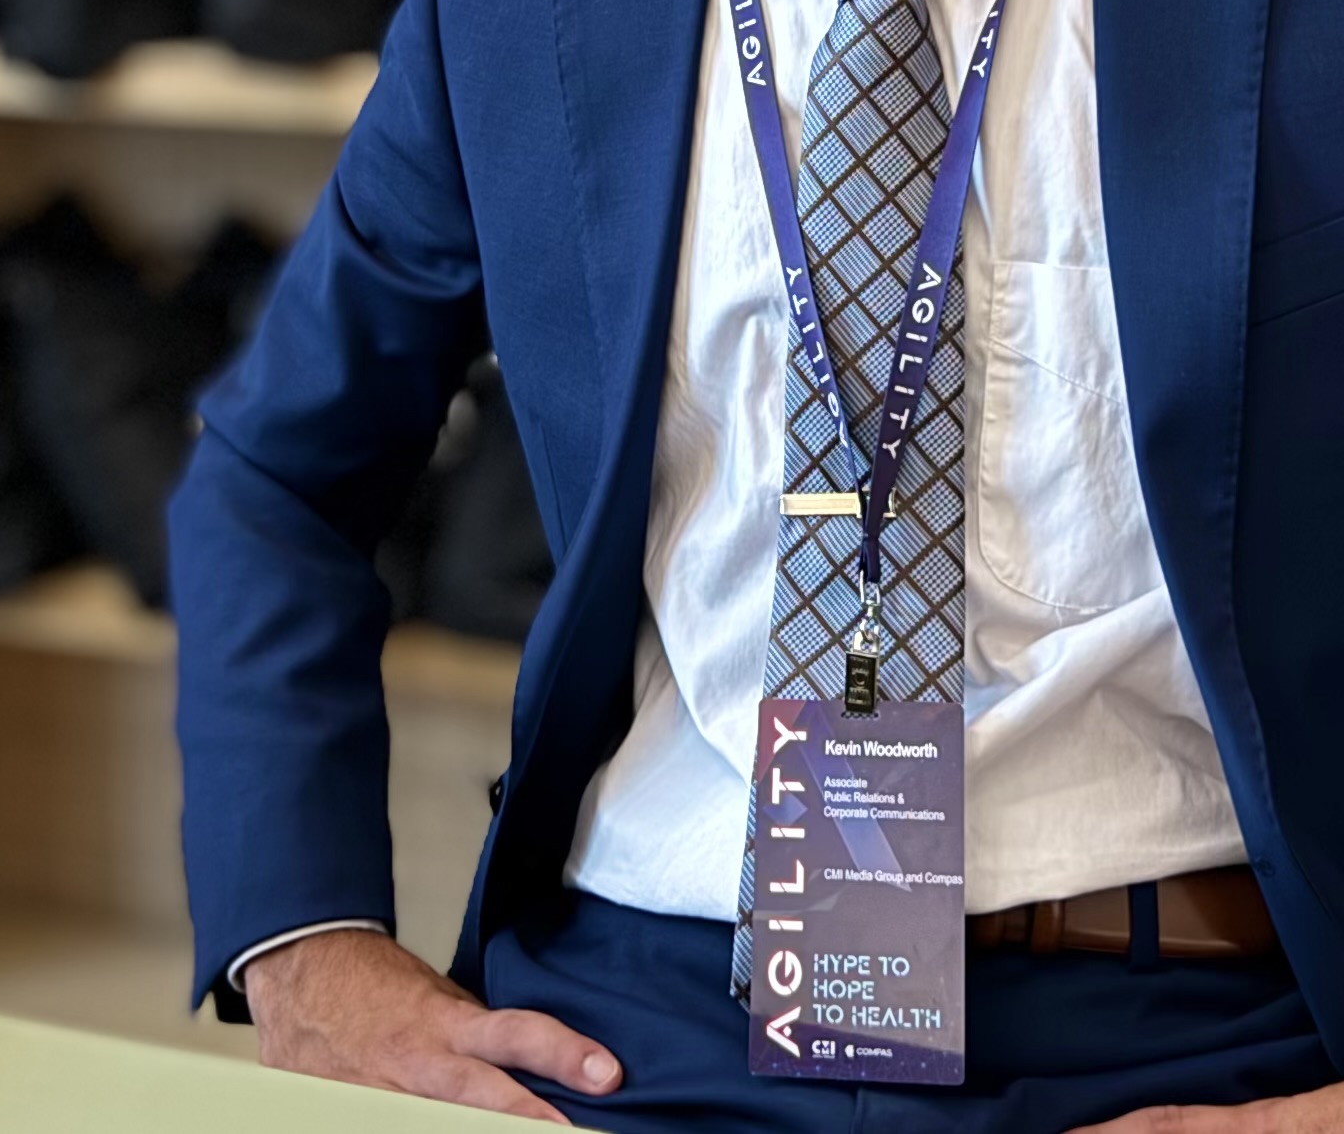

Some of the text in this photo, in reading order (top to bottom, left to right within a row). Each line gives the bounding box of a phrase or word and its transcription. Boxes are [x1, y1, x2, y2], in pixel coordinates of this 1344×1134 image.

[882, 262, 942, 460] AGILITY
[825, 740, 938, 758] Kevin Woodworth
[824, 776, 867, 788] Associate
[824, 791, 904, 804] Public Relations &
[824, 806, 945, 821] Corporate Communications
[824, 868, 963, 886] CMI Media Group and Compas
[766, 716, 807, 1058] AGILITY
[813, 953, 910, 977] HYPE TO
[813, 979, 875, 1000] HOPE
[812, 1004, 941, 1029] TO HEALTH
